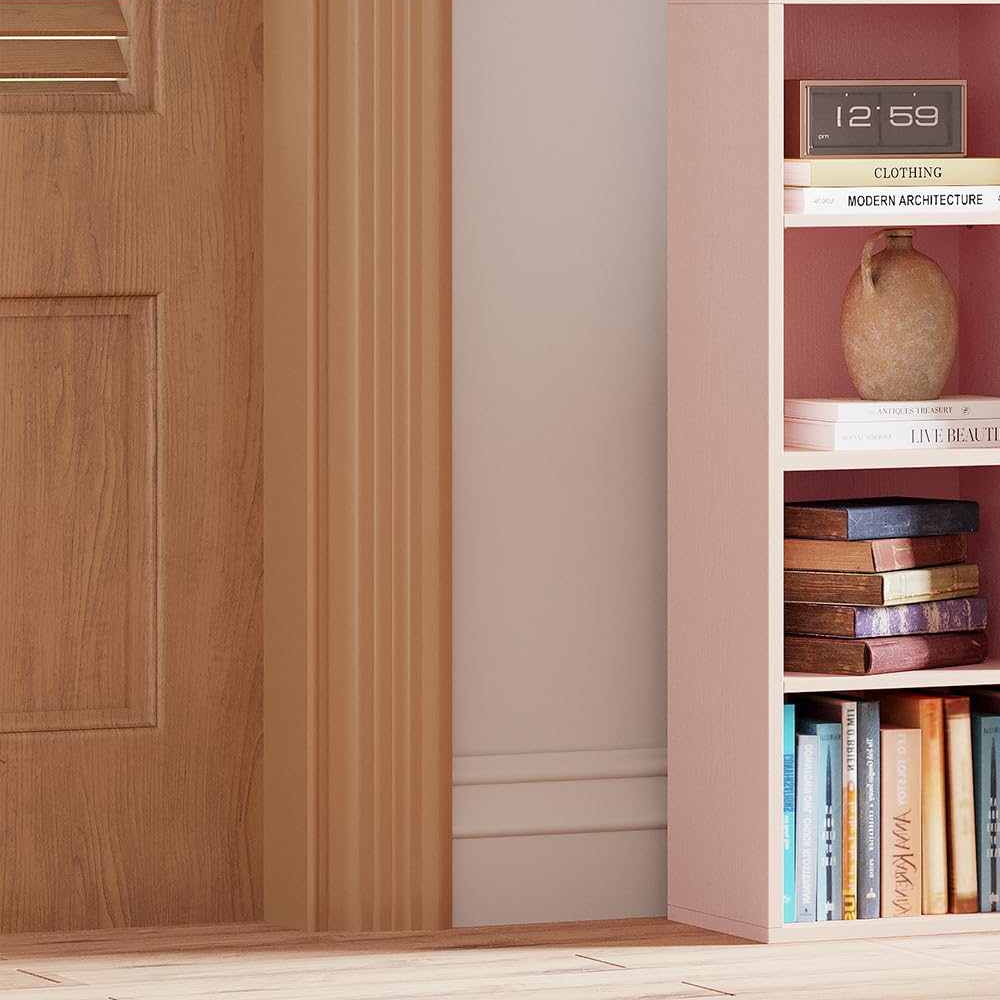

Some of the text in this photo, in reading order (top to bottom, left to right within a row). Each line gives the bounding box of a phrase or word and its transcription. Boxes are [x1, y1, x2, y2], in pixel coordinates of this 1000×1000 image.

[874, 167, 943, 179] CLOTHING
[847, 195, 895, 206] MODERN
[898, 194, 984, 206] ARCHITECTURE
[877, 405, 953, 416] ANTIQUES TREASURY
[911, 429, 945, 444] LIVE
